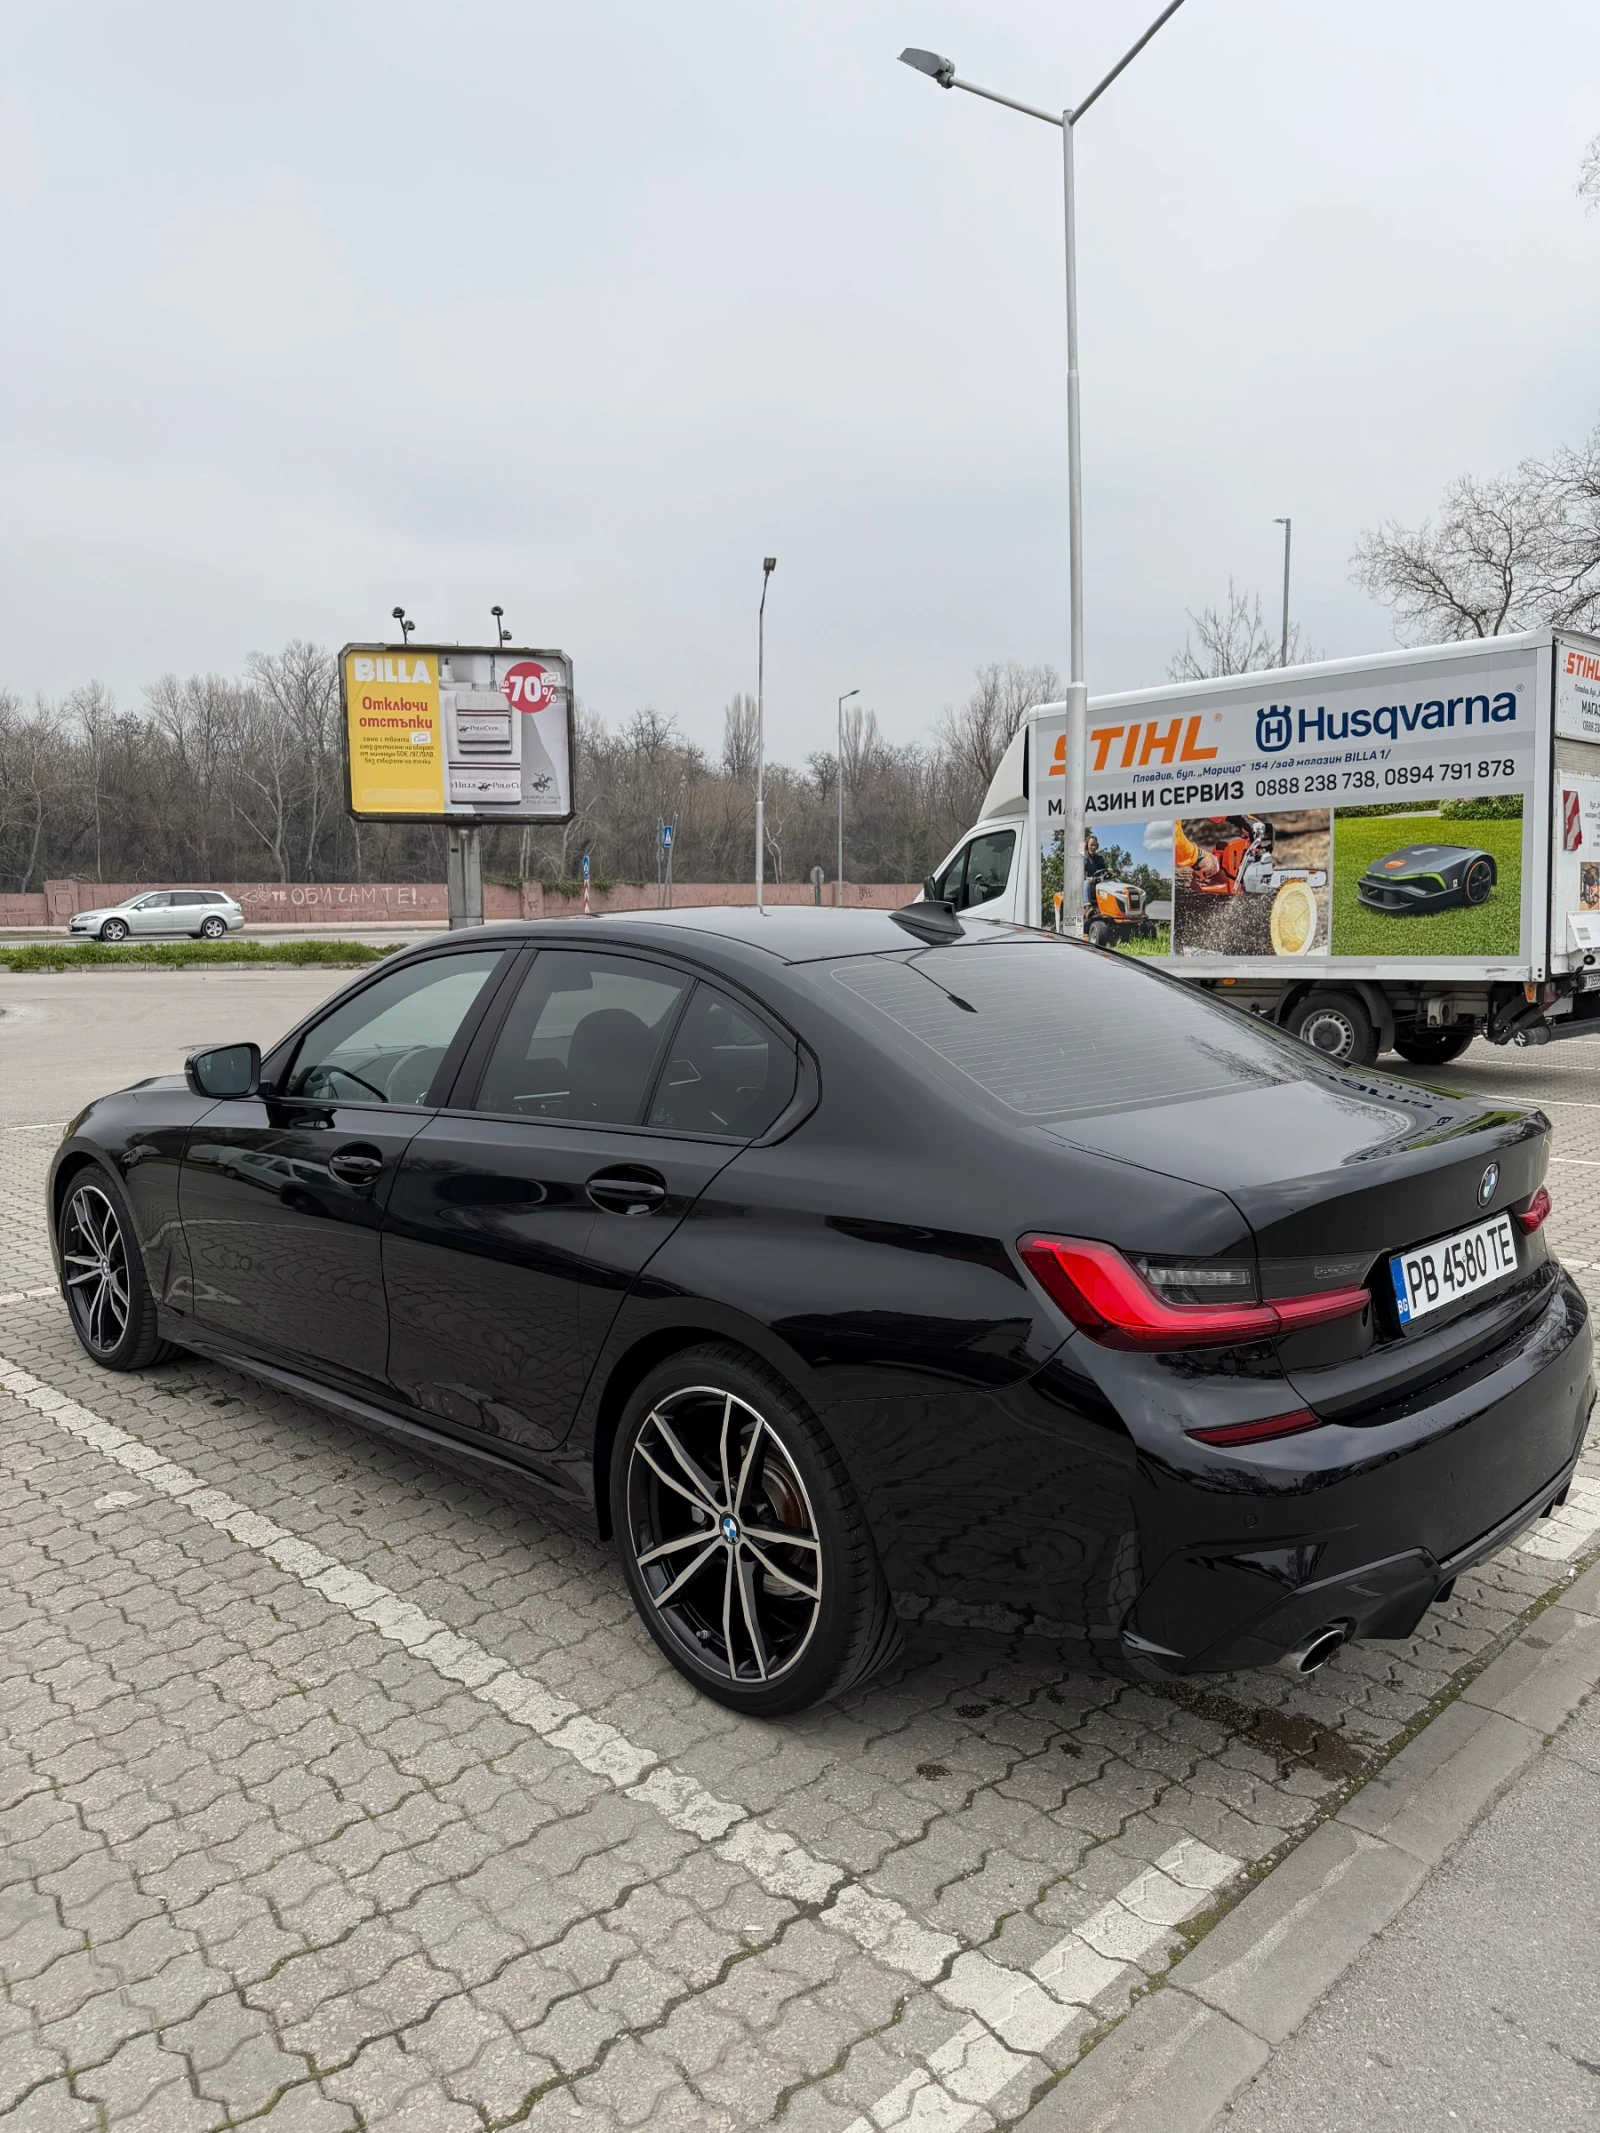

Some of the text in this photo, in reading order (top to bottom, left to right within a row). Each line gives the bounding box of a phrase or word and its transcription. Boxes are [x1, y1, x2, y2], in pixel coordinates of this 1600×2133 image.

[354, 658, 431, 684] BILLA
[362, 696, 428, 711] Отключи
[500, 676, 557, 702] -70%
[359, 714, 433, 729] отстъпки
[1298, 692, 1517, 743] Husqvarna
[1133, 771, 1174, 784] Пловдив,
[1176, 769, 1196, 782] бул.
[1250, 761, 1268, 771] 154
[1270, 758, 1295, 770] /зад
[1296, 755, 1342, 767] магазин
[1344, 751, 1377, 763] BILLA
[1048, 759, 1515, 816] МАЗИН И СЕРВИЗ 0888 238 738, 0894 791 878
[1406, 1222, 1514, 1308] PB 4580 TE
